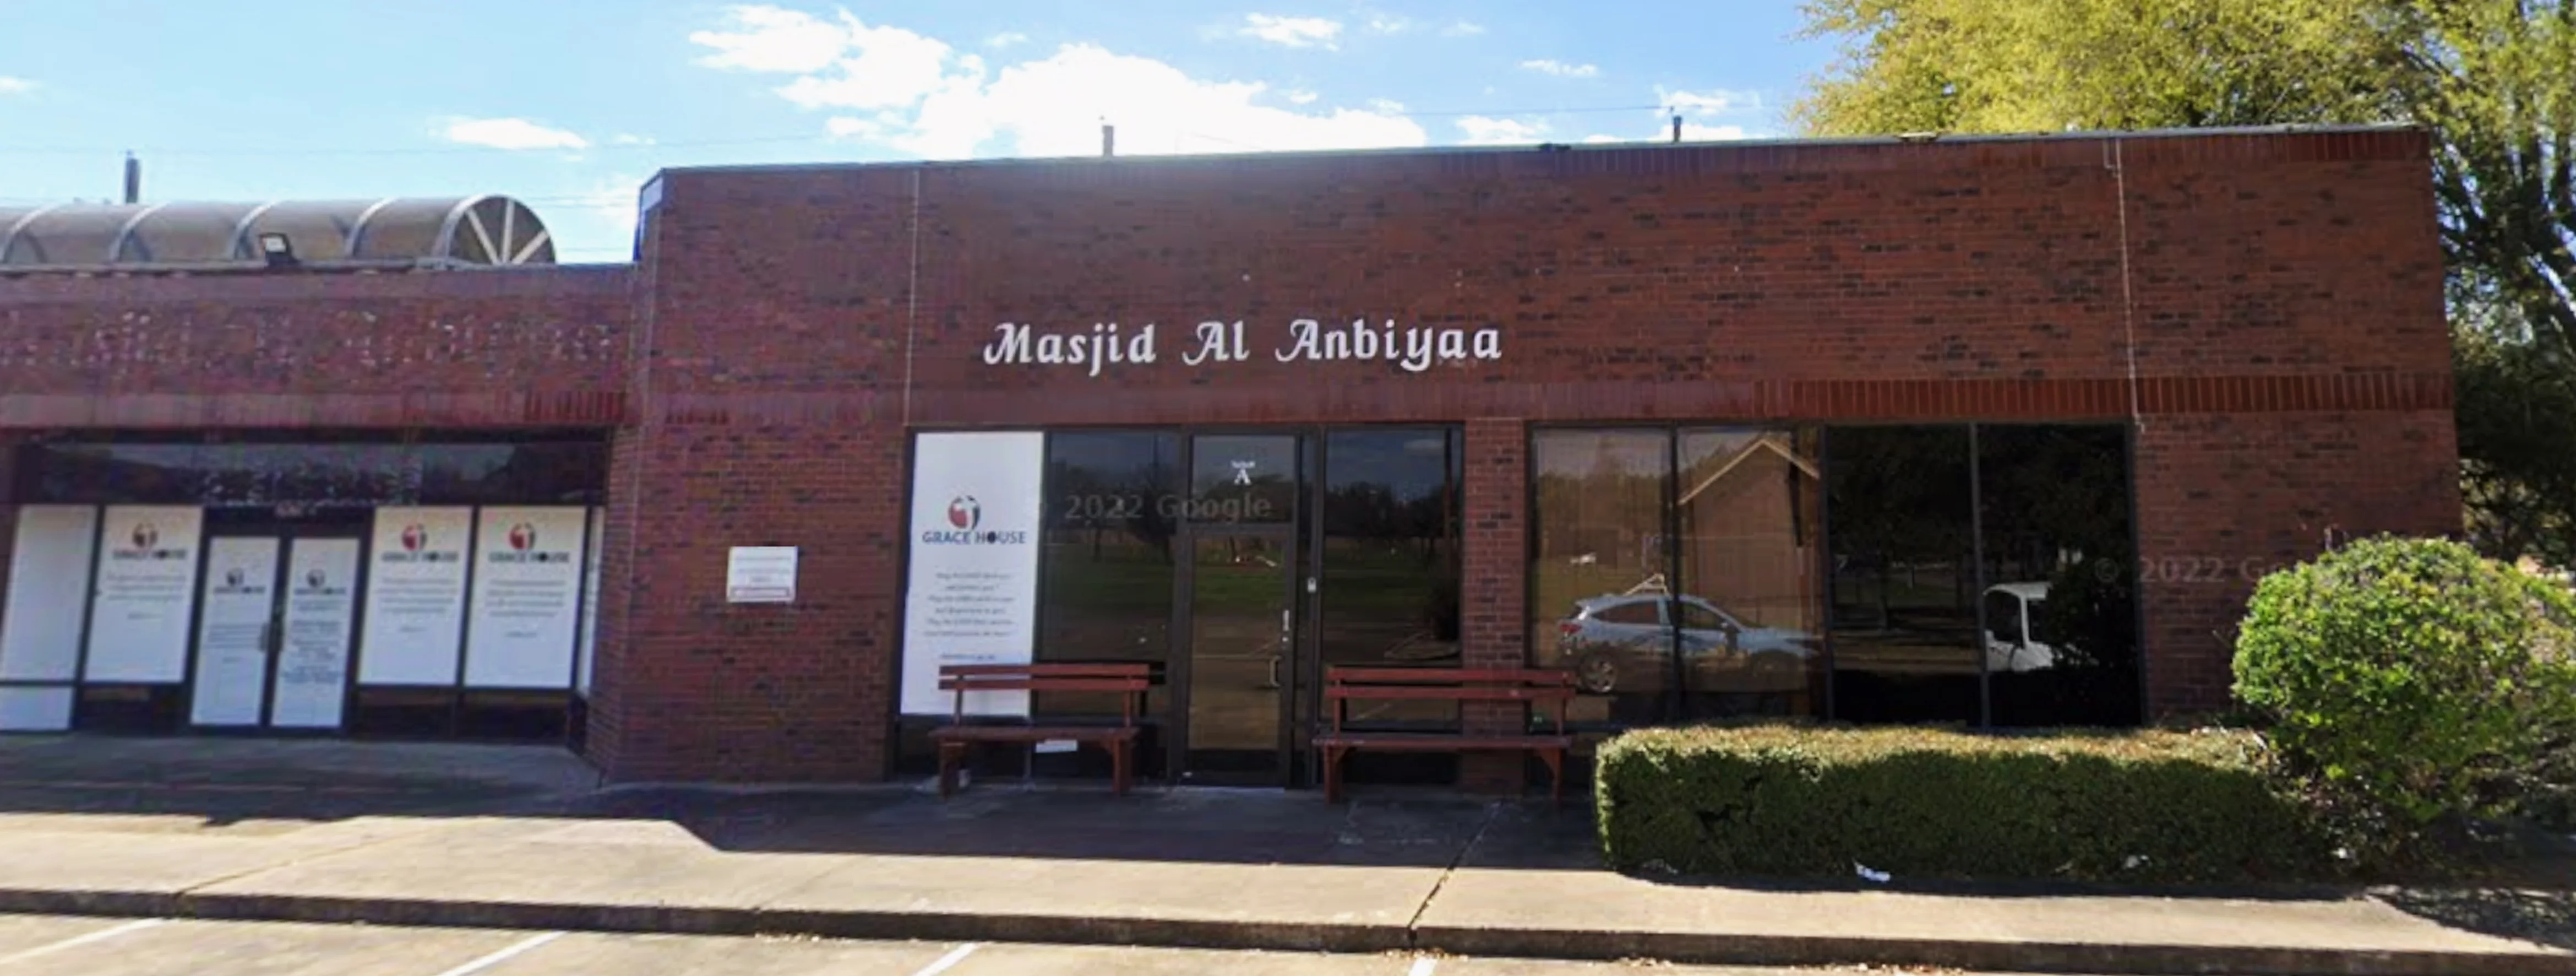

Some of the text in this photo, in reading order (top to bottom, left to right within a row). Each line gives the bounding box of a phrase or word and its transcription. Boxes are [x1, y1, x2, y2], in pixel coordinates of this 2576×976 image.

[983, 318, 1502, 377] Masjid Al Anbiyaa
[922, 531, 971, 545] GRACE
